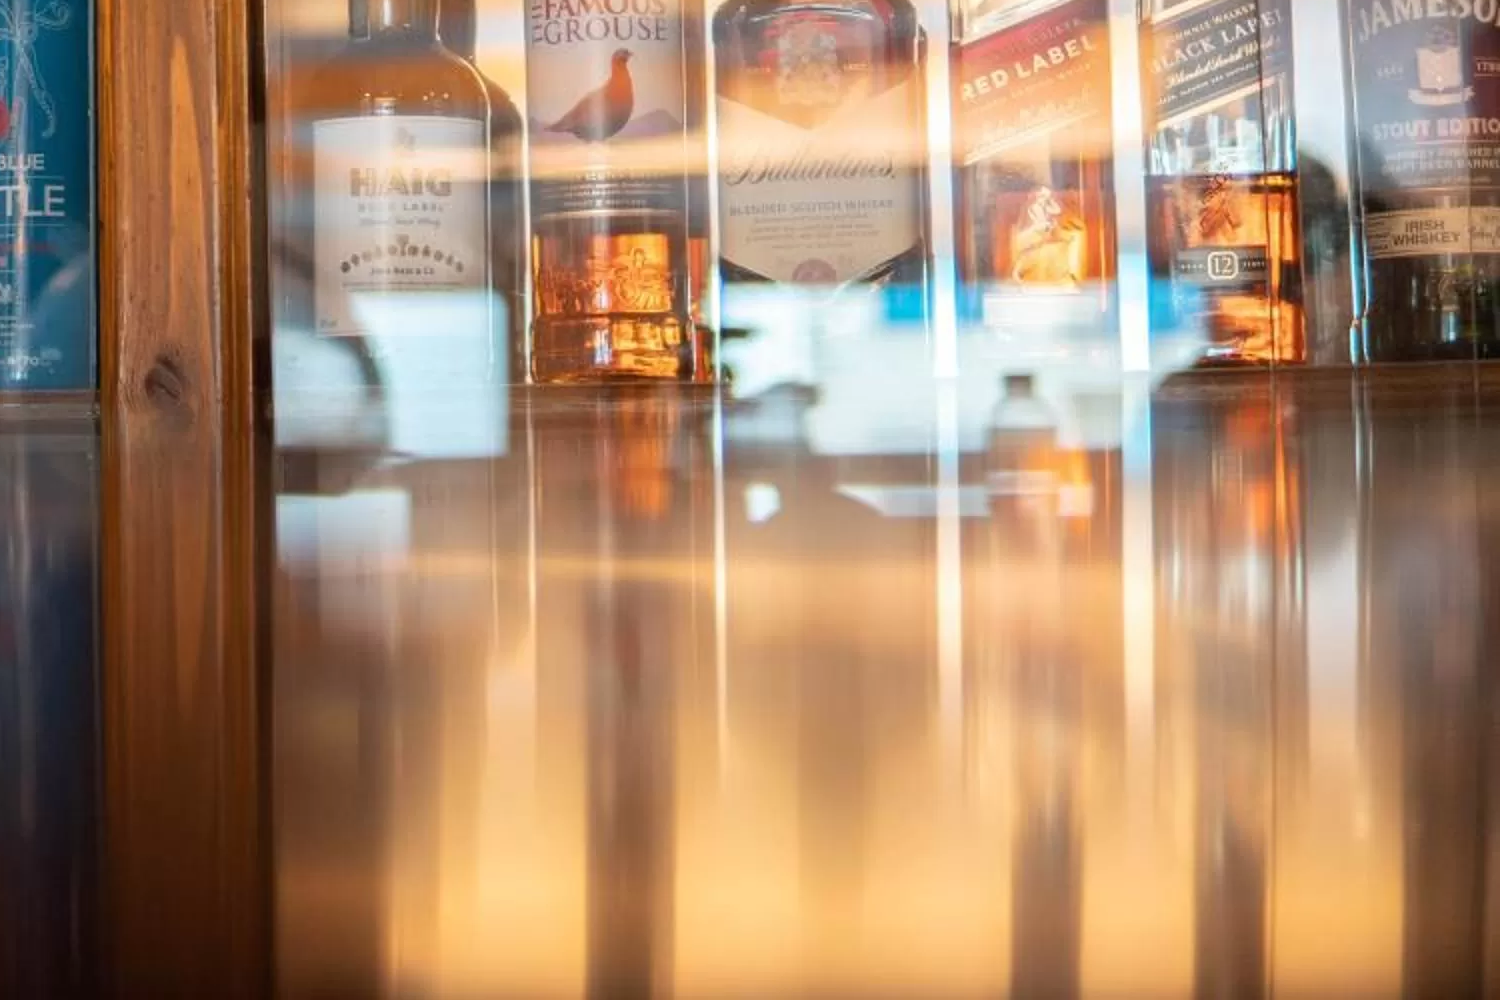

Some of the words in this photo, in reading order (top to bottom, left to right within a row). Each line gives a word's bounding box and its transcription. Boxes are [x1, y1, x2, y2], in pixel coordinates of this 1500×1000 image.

[543, 16, 669, 45] GROUSE
[961, 68, 1010, 101] RED
[1014, 34, 1096, 80] LABEL
[1373, 119, 1431, 142] STOUT
[350, 167, 453, 197] HAIG
[1405, 220, 1445, 233] IRISH
[1393, 231, 1461, 248] WHISKEY
[1213, 256, 1233, 274] 12
